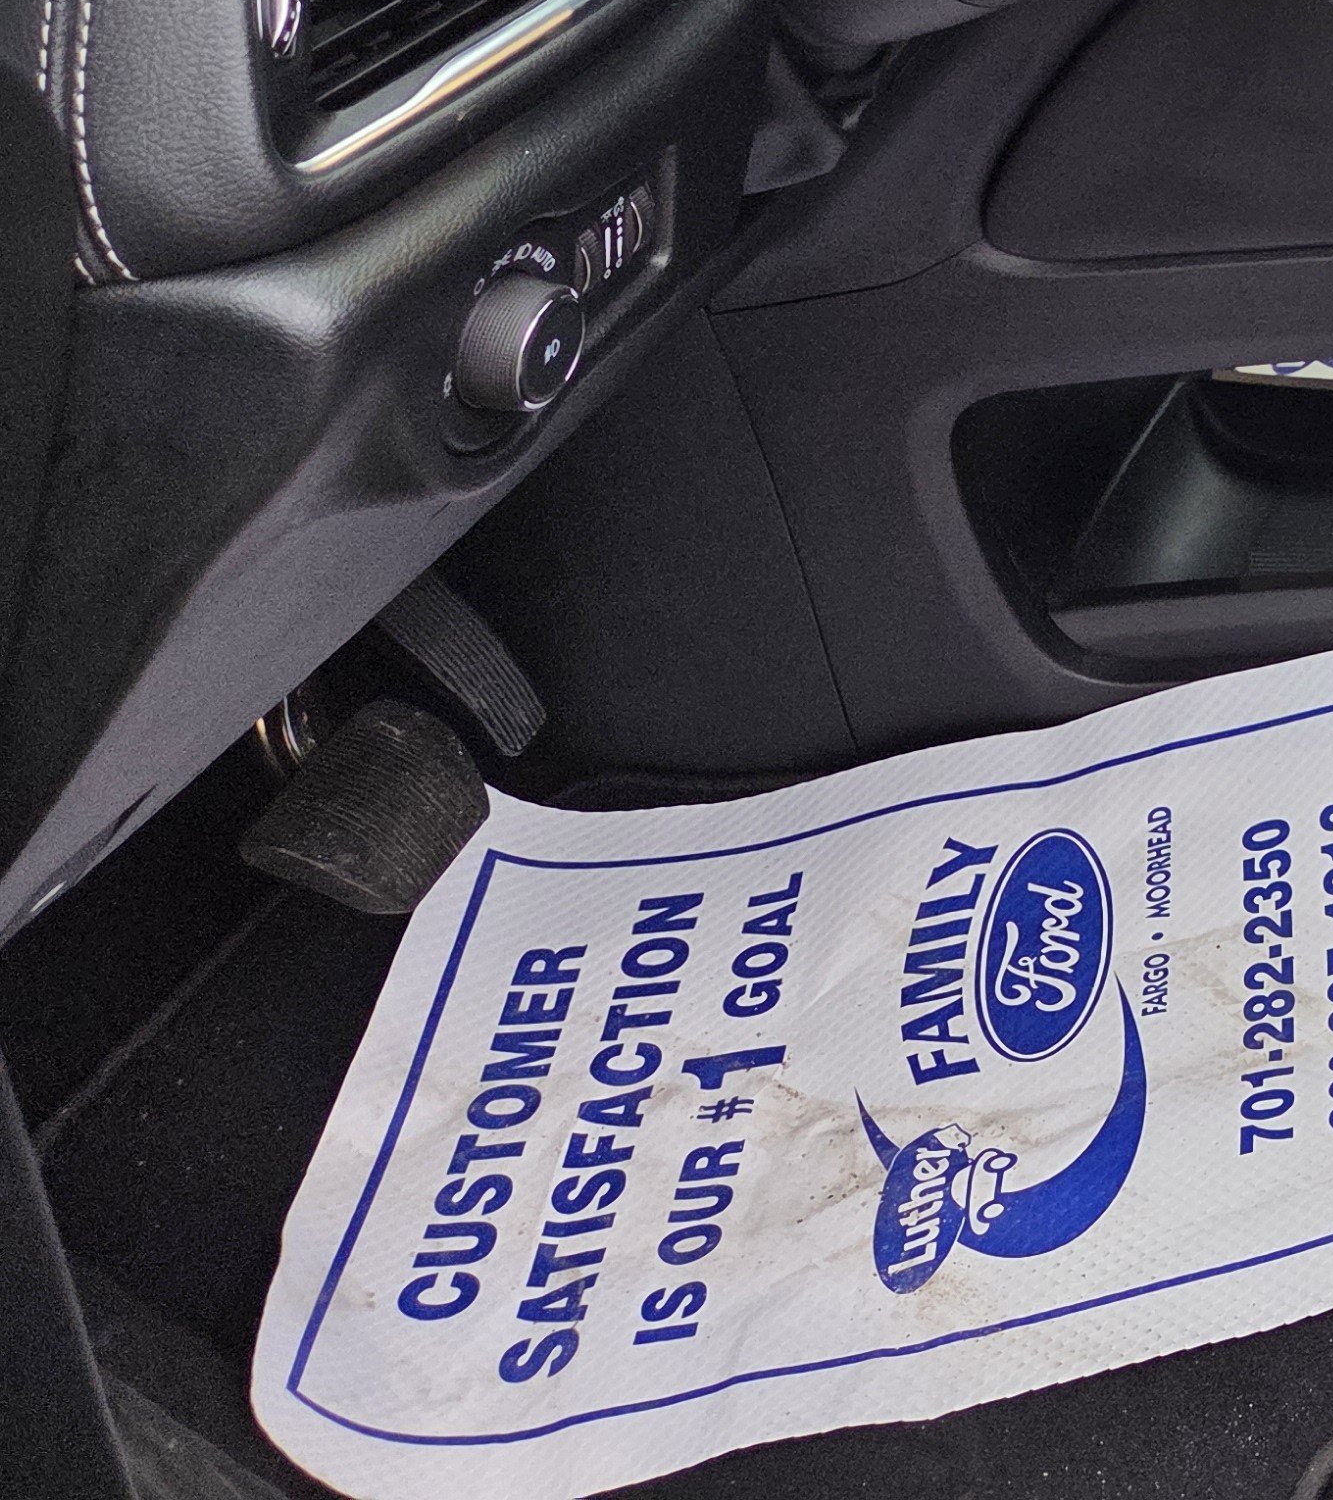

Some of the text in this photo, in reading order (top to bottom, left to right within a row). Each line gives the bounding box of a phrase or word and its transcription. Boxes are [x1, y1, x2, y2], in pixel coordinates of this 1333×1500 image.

[530, 246, 556, 272] AUTO
[900, 837, 999, 1085] FAMILY
[995, 878, 1085, 1013] Ford
[1141, 806, 1173, 1017] FARGO MOORHEAD
[1239, 818, 1295, 1156] 701-282-2350
[397, 944, 587, 1322] CUSTOMER
[498, 893, 703, 1385] SATISFACTION
[634, 872, 803, 1346] IS OUR #1 GOAL
[887, 1143, 954, 1276] Luther
